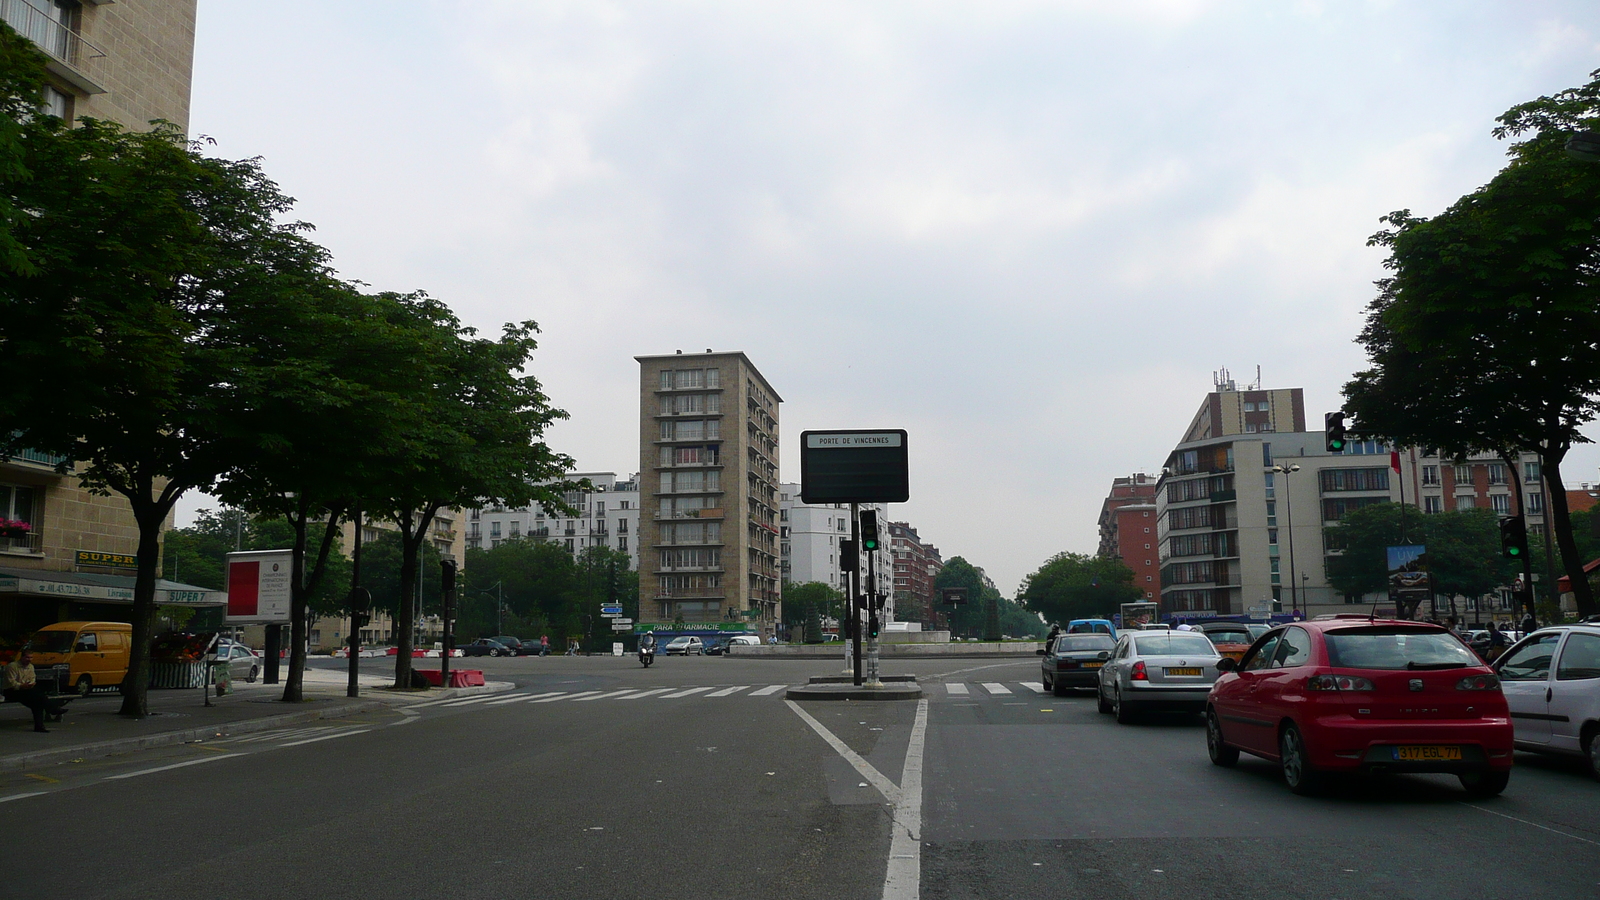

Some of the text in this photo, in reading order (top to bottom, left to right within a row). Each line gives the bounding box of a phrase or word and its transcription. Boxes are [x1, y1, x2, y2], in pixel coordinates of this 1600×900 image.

[854, 436, 889, 444] VINCENNES
[79, 552, 135, 564] SUPER
[169, 591, 206, 602] SUPER 7
[1400, 747, 1460, 759] 317 EGL 77
